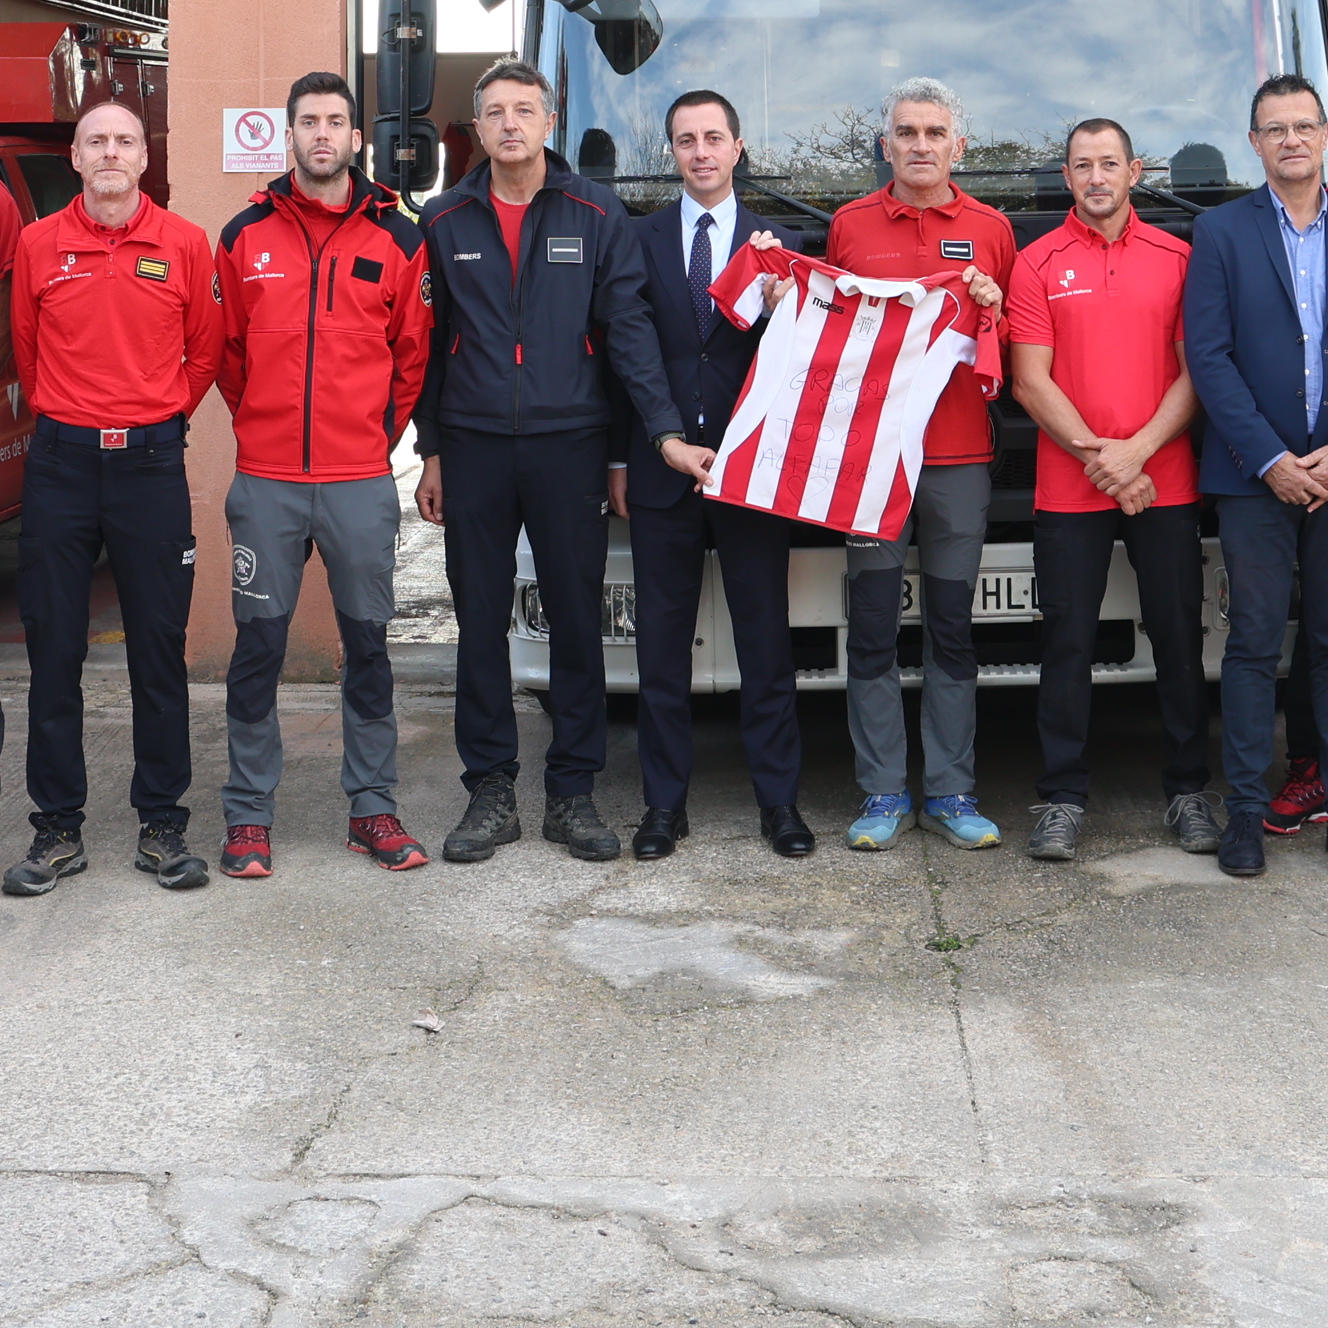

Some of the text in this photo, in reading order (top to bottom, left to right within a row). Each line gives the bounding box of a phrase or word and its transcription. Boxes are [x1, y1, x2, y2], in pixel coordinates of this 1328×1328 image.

[812, 297, 845, 314] mass
[818, 394, 865, 417] POR
[777, 418, 861, 447] TODO
[12, 437, 22, 457] de
